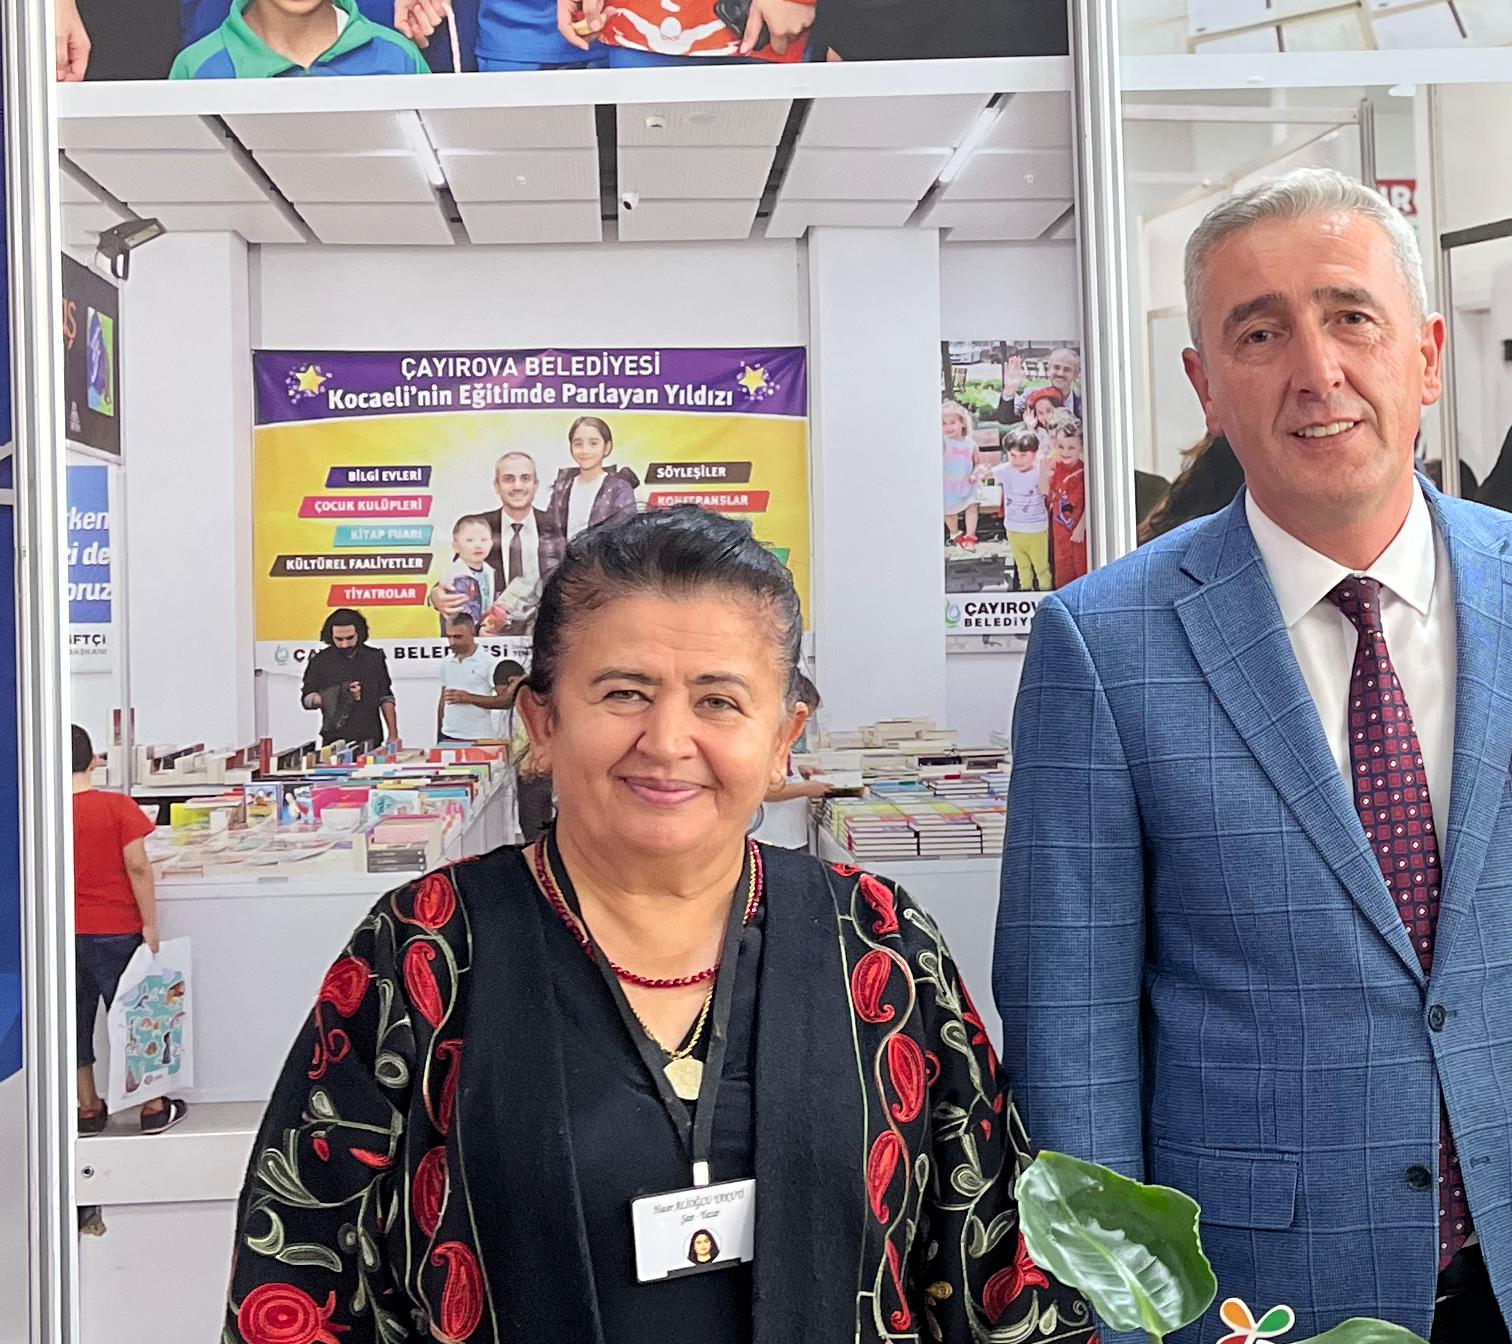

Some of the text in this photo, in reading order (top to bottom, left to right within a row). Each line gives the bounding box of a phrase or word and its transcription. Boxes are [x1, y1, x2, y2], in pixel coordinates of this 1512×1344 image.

[401, 351, 660, 381] ÇAYIROVA BELEDİYESİ
[459, 382, 556, 409] Eğitimde
[562, 383, 659, 409] Parlayan
[664, 384, 733, 406] Yıldızı
[348, 468, 422, 483] BİLGİ EVLERİ
[656, 464, 727, 480] SÖYLEŞİLER
[314, 497, 422, 514] ÇOCUK KULÜPLERİ
[350, 527, 422, 541] KİTAP FUARI
[82, 541, 111, 566] de
[286, 555, 424, 571] KÜLTÜREL FAALİYETLER
[344, 586, 416, 600] TİYATROLAR
[964, 601, 1036, 617] ÇAYIROV
[964, 617, 1028, 628] BELEDİY
